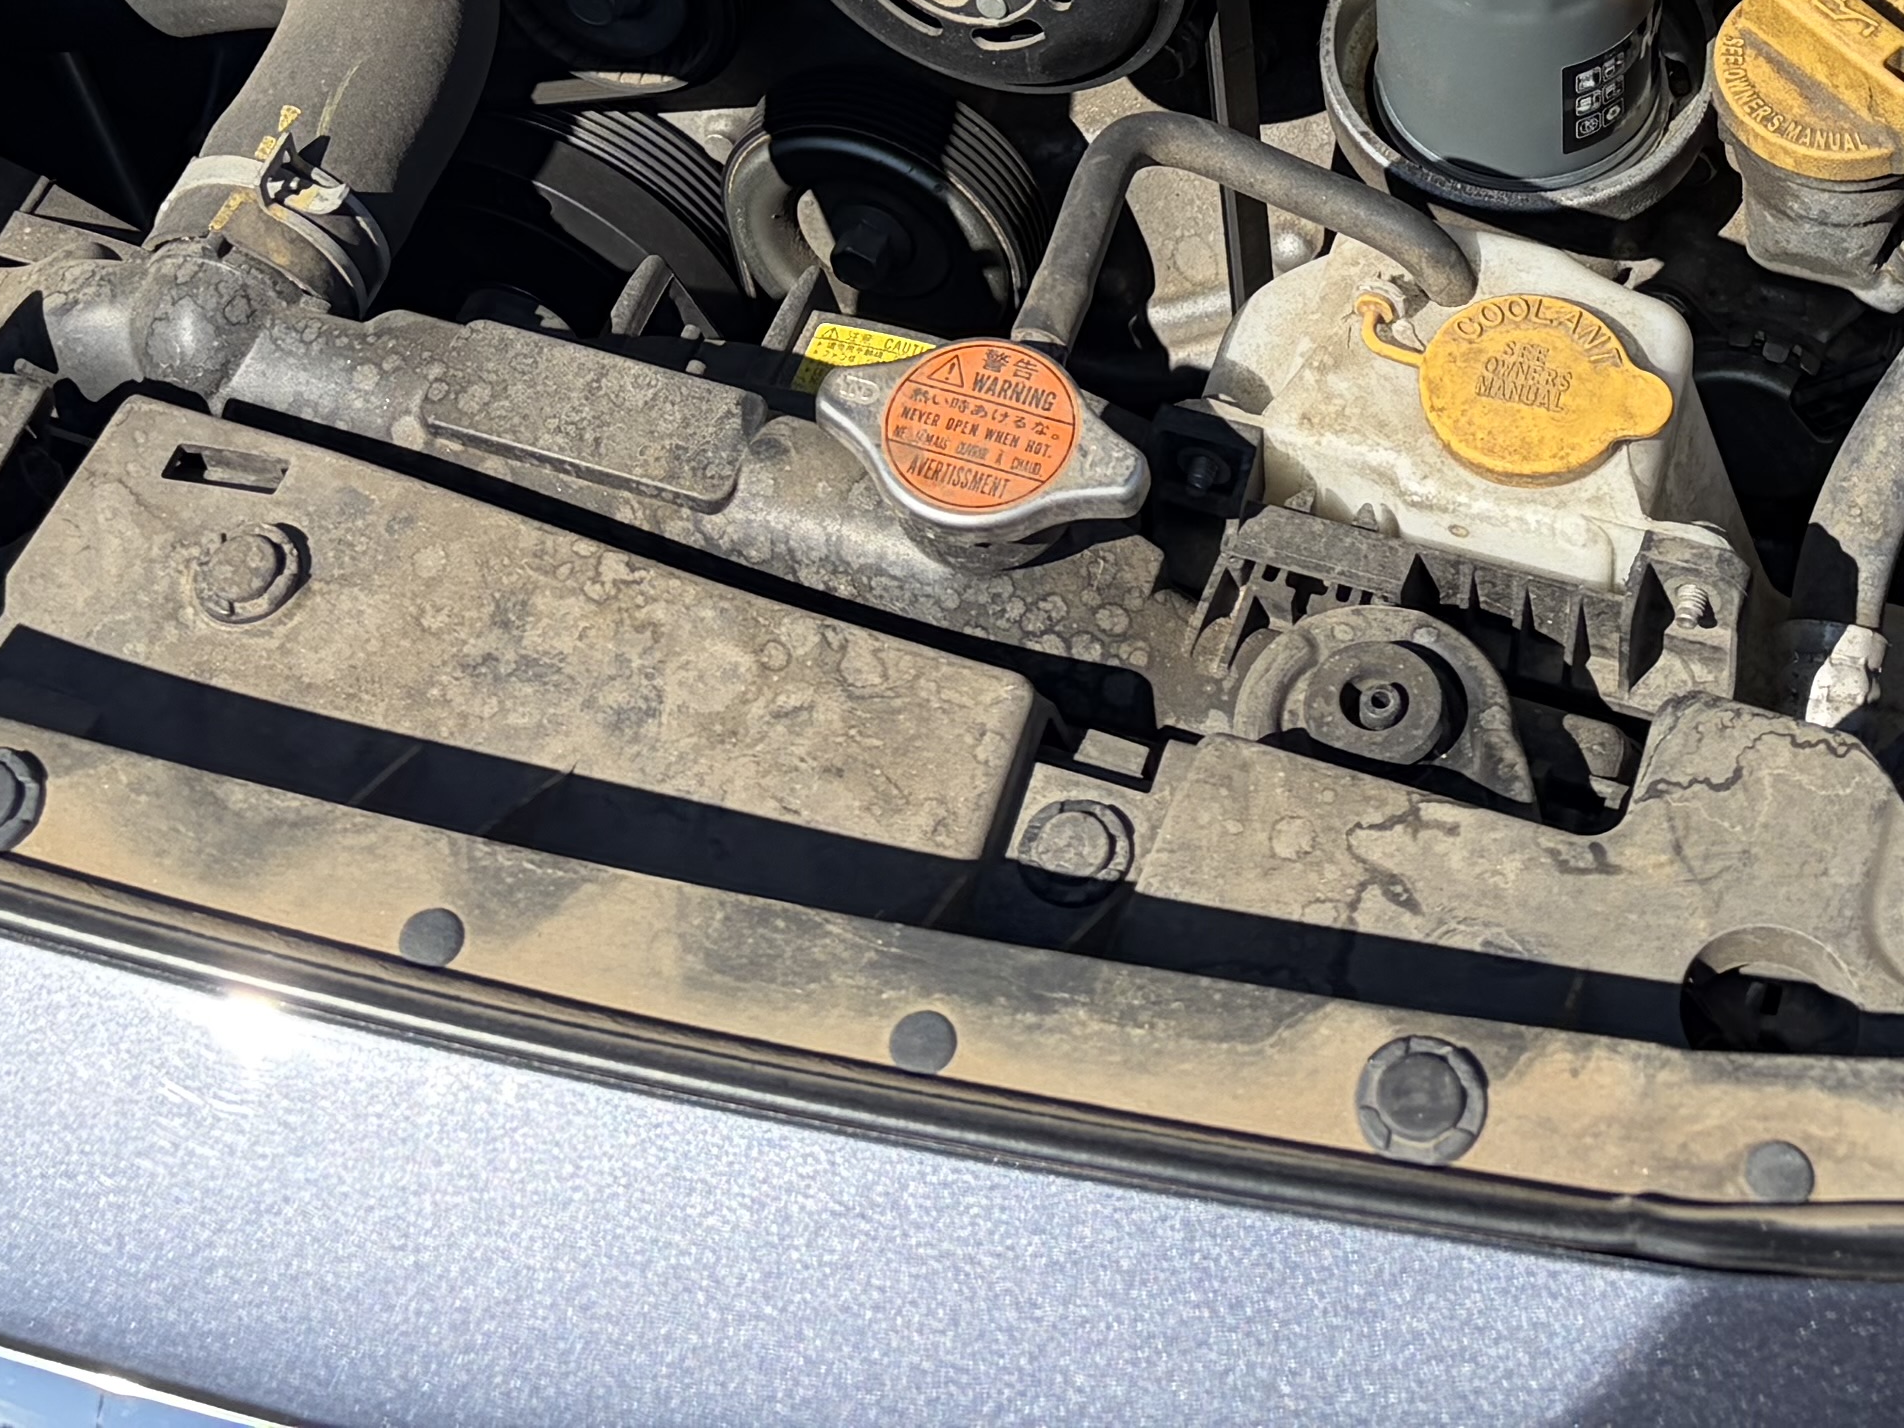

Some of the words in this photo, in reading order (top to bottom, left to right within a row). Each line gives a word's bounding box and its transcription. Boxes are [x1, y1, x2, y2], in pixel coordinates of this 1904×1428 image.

[1722, 35, 1745, 66] SEE
[1724, 66, 1784, 132] OWNER'S
[1784, 120, 1869, 152] MANUAL
[883, 337, 925, 356] CAUTI
[1455, 295, 1624, 369] COOLANT
[982, 348, 1039, 381] 警告
[1501, 340, 1551, 365] SEE
[972, 371, 1058, 412] WARNING
[1475, 375, 1566, 412] MANUAL
[900, 405, 941, 427] NEVER
[946, 416, 979, 437] OPEN
[984, 426, 1021, 449] WHEN
[1024, 439, 1053, 459] HOT.
